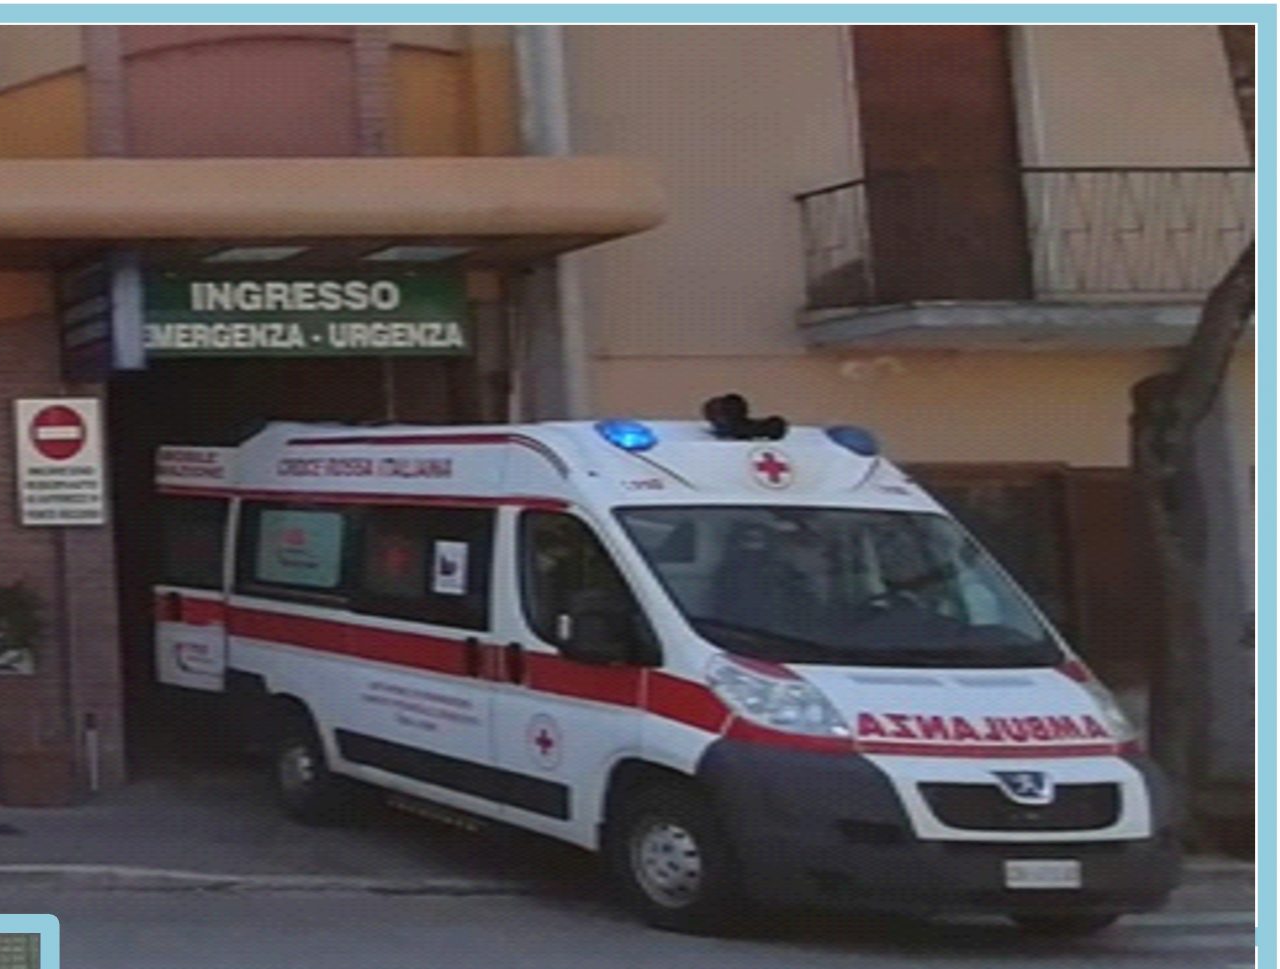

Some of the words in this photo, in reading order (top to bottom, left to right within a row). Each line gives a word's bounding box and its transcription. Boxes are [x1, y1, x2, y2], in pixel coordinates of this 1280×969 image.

[190, 281, 401, 311] INGRESSO
[329, 322, 465, 349] URGENZA
[324, 457, 374, 477] ROSSA
[378, 457, 452, 478] ITALIANA
